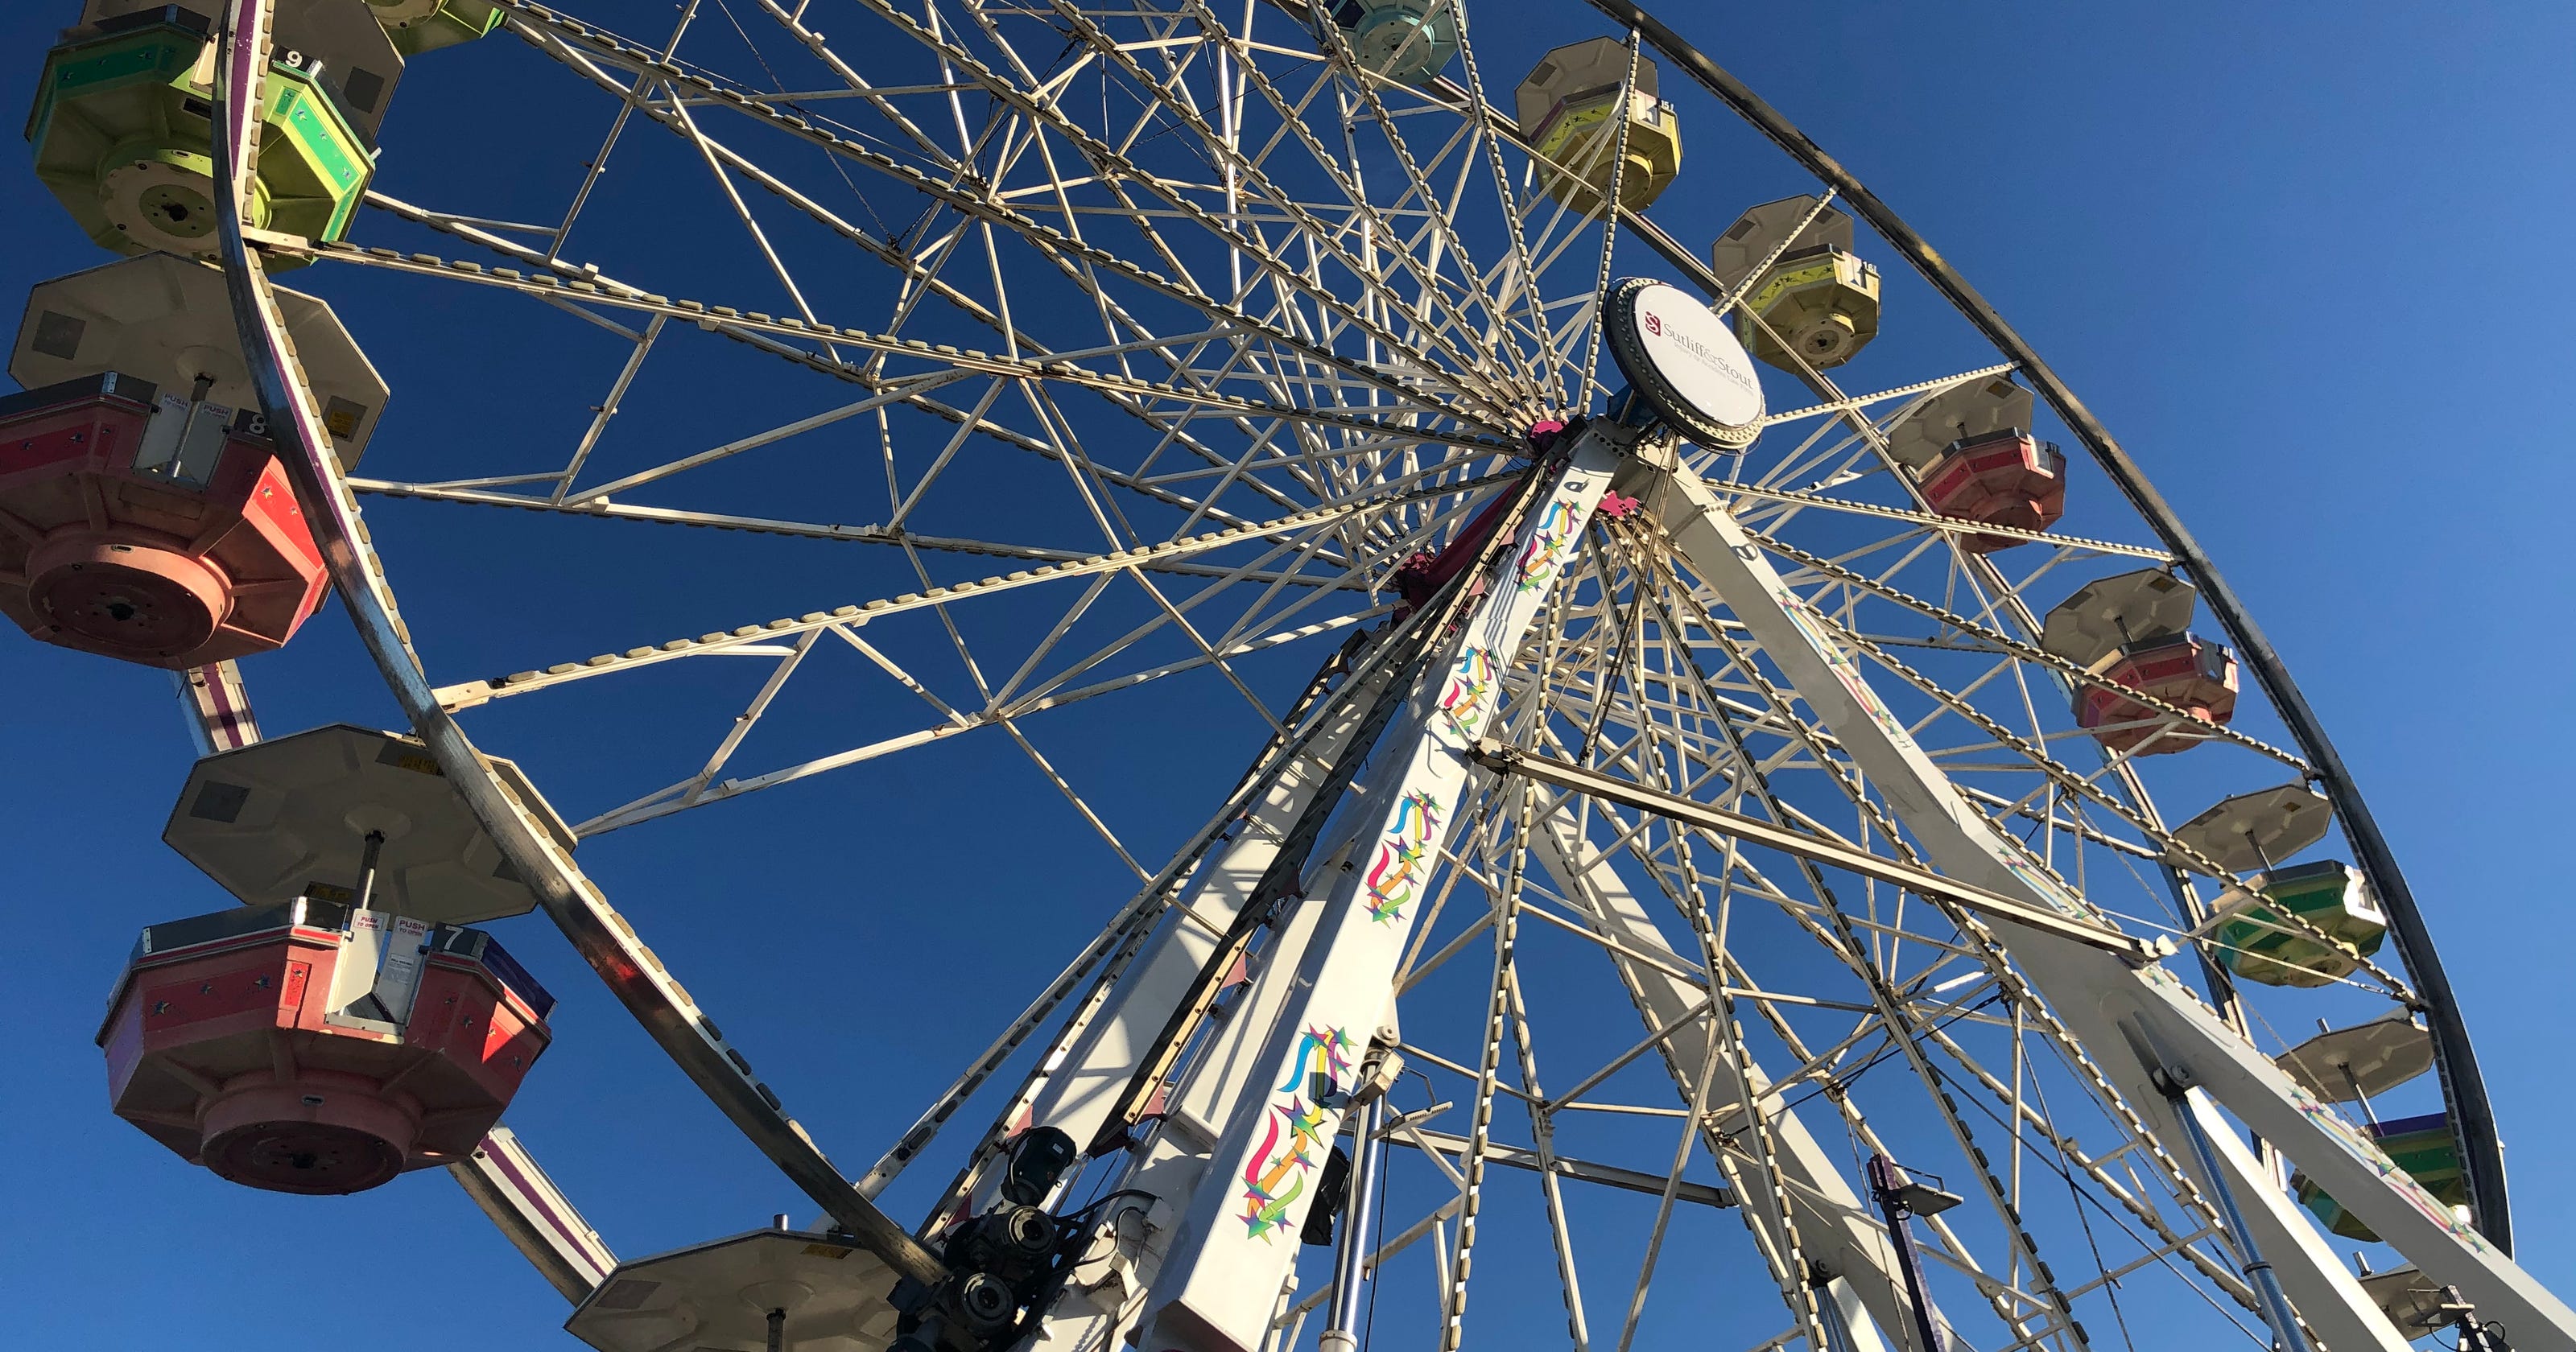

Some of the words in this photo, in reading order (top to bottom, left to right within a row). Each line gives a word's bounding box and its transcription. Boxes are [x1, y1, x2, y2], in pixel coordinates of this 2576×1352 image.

[285, 51, 303, 68] 9
[163, 393, 189, 407] PUSH
[203, 405, 229, 415] PUSH
[249, 413, 266, 435] 8
[361, 916, 378, 924] PUSH
[398, 920, 426, 931] PUSH
[444, 925, 464, 950] 7
